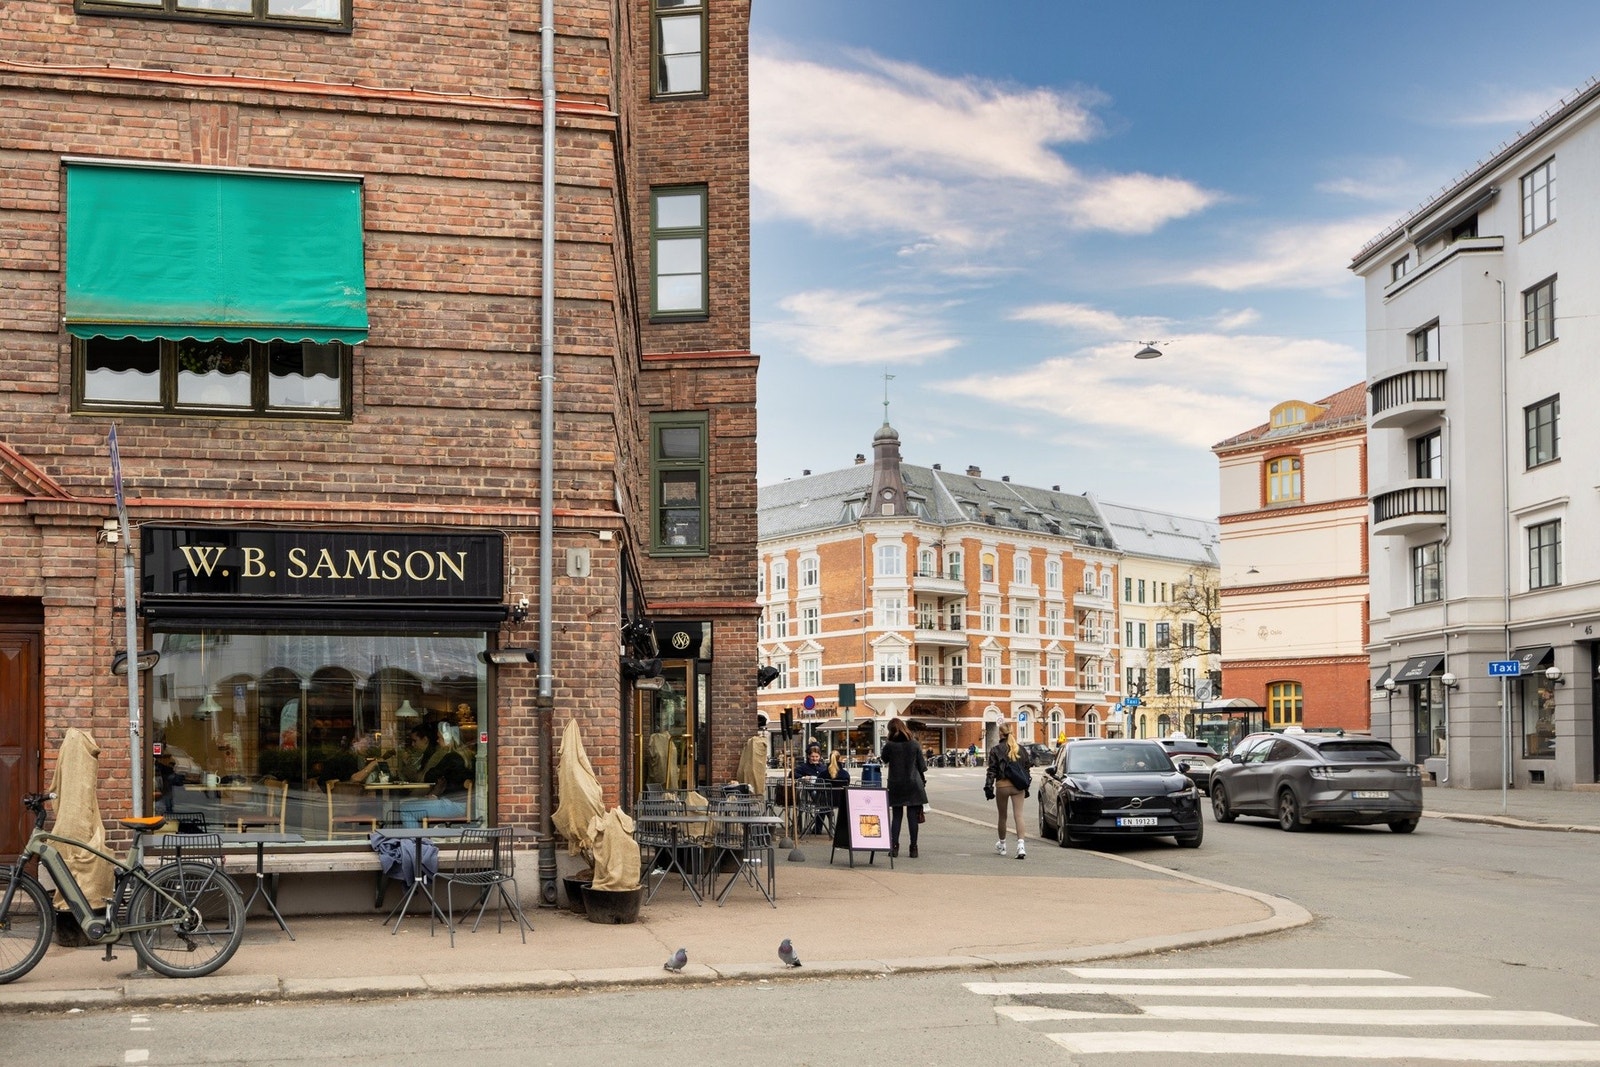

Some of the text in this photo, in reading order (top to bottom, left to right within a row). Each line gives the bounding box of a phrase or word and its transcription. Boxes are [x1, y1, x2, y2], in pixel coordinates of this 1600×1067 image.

[179, 546, 467, 581] W. B. SAMSON
[1585, 625, 1592, 635] 45
[1491, 662, 1517, 672] Taxi
